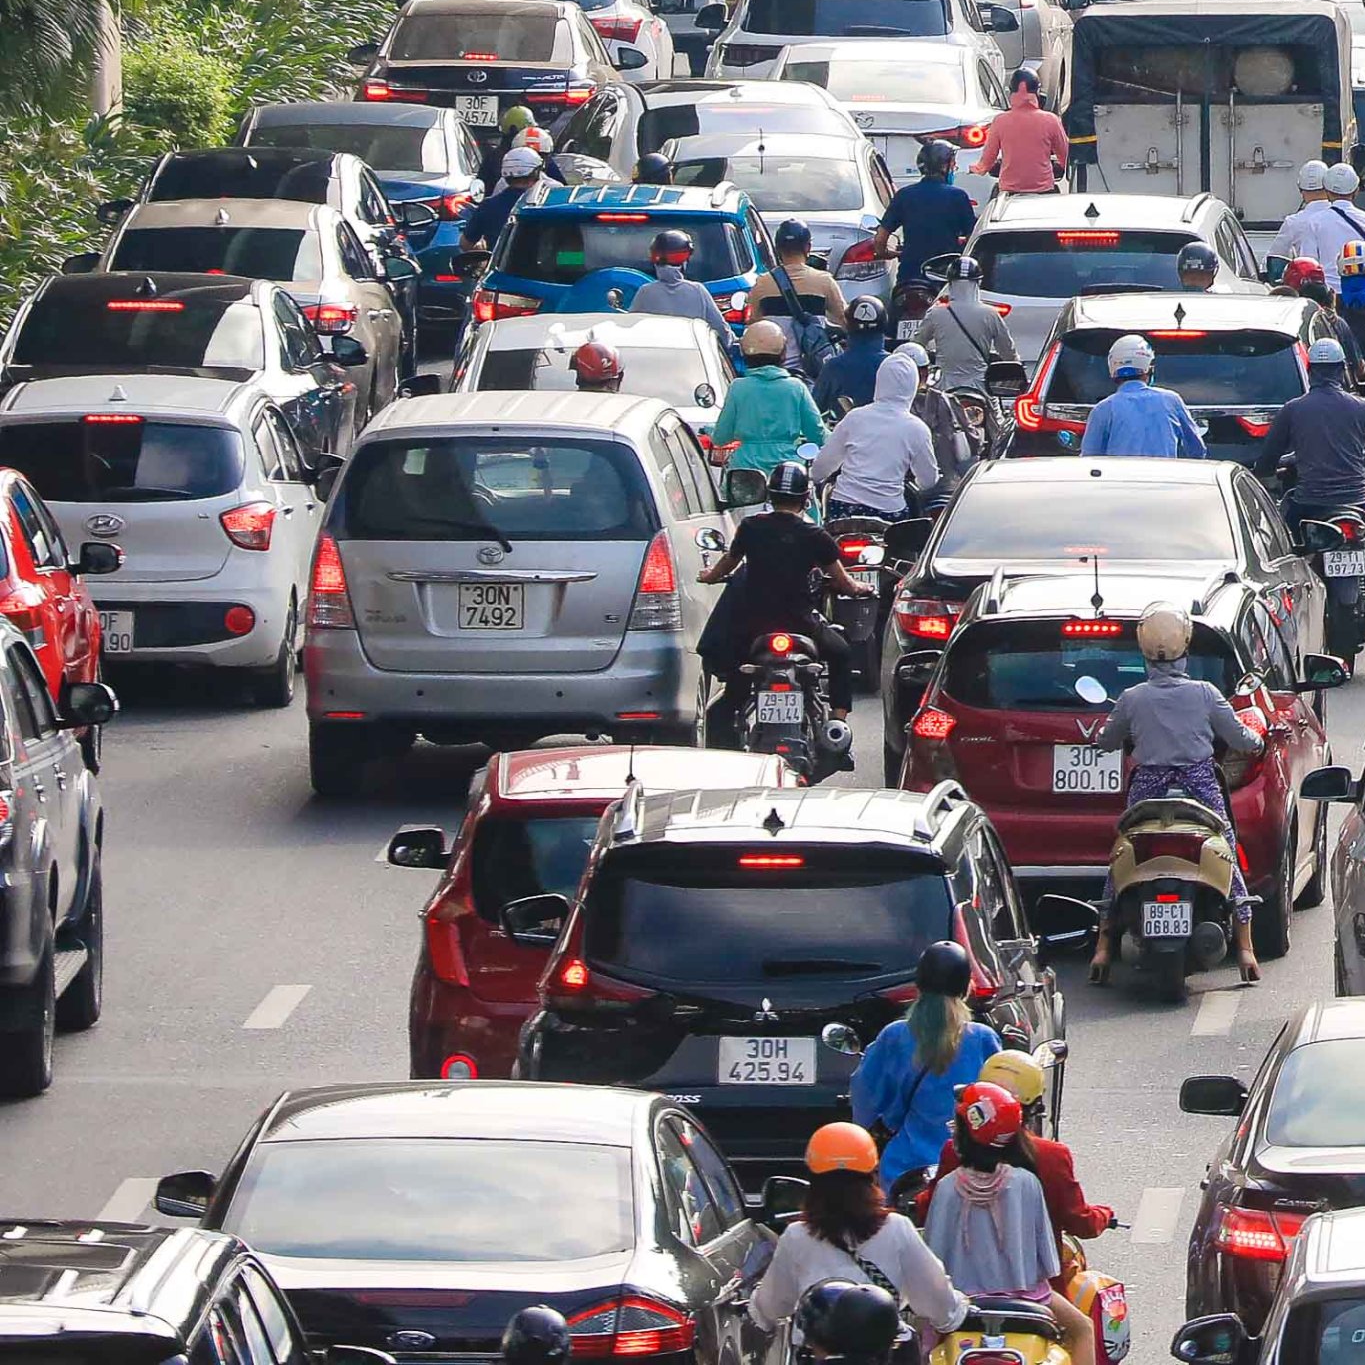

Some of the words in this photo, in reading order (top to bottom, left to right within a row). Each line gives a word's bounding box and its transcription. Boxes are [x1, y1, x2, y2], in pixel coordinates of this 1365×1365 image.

[1328, 563, 1364, 576] 997.73
[472, 585, 511, 606] 30N
[466, 606, 517, 627] 7492
[760, 708, 800, 722] 671.44
[1055, 770, 1120, 790] 800.16
[1150, 904, 1185, 919] 89-C1
[1145, 919, 1188, 935] 068.83
[746, 1038, 788, 1059] 30H
[728, 1062, 805, 1082] 425.94
